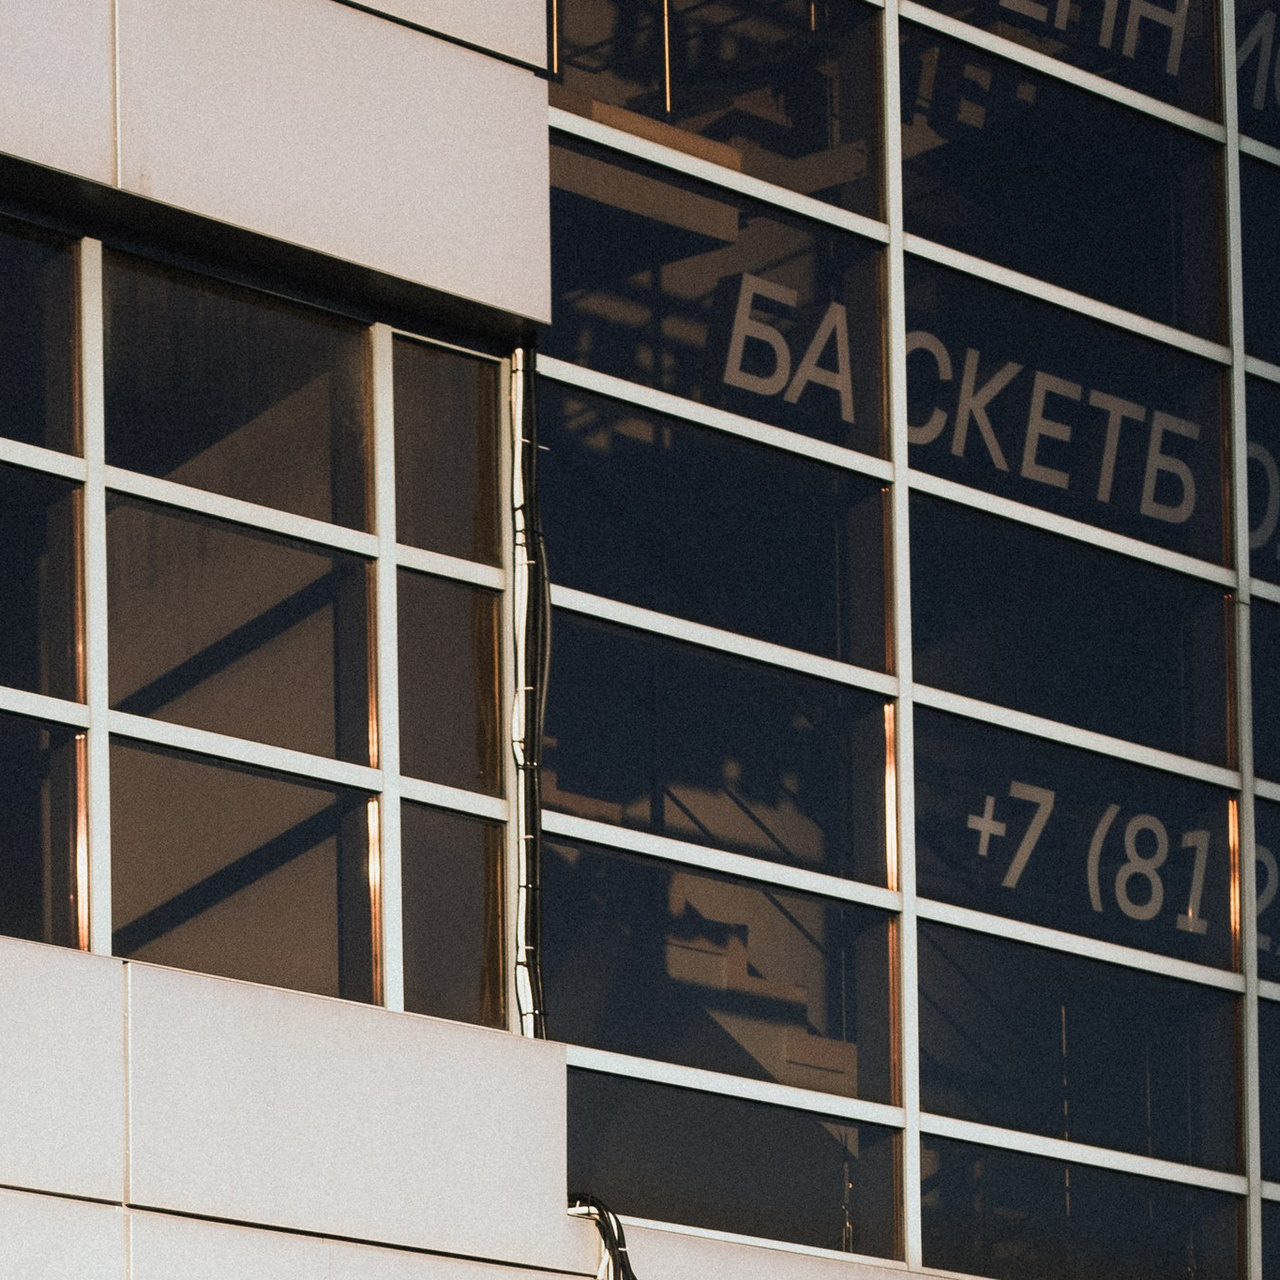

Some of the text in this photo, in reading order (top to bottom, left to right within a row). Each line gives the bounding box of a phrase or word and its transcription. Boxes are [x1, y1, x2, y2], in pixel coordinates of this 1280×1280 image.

[723, 273, 1280, 557] БАСКЕТБО
[967, 780, 1280, 956] +7 (812
